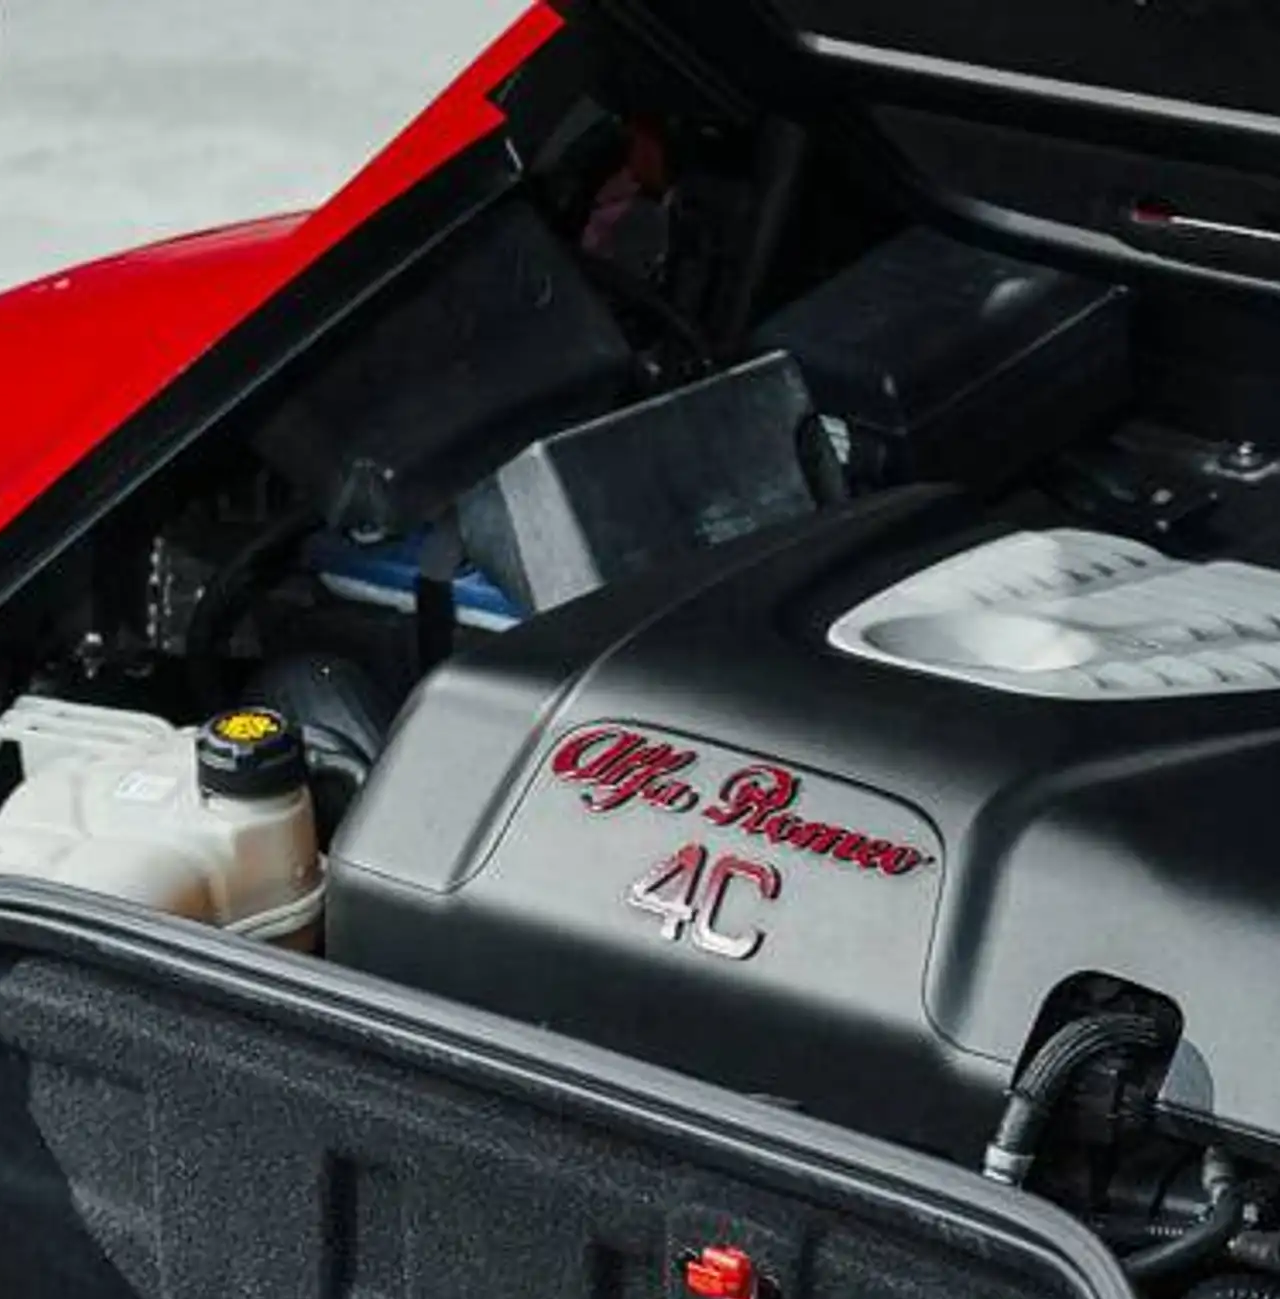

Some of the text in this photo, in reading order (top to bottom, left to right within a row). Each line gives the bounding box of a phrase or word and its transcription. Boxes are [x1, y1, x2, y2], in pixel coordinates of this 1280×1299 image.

[552, 726, 934, 875] Alfa Romeo
[627, 842, 781, 960] 4C
